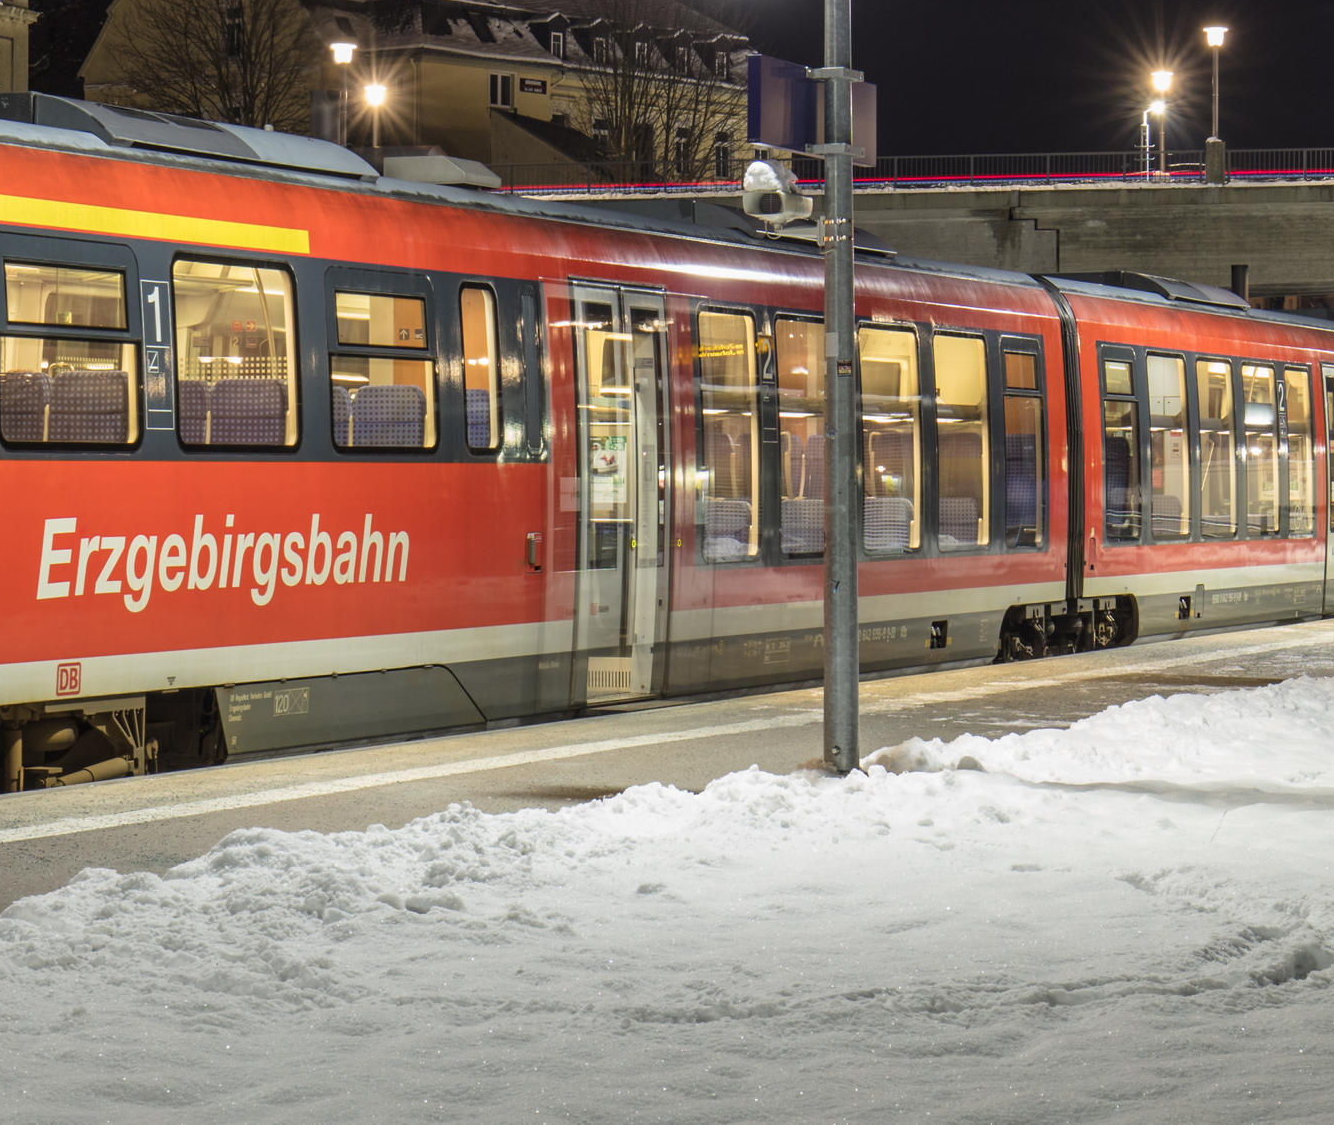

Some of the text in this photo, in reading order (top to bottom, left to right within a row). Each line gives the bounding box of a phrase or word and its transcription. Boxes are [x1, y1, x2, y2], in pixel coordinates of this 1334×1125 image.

[147, 286, 162, 342] 1
[762, 338, 773, 379] 2
[1278, 383, 1285, 411] 2
[36, 513, 410, 613] Erzgebirgsbahn
[58, 666, 79, 692] DB
[275, 694, 290, 714] 120
